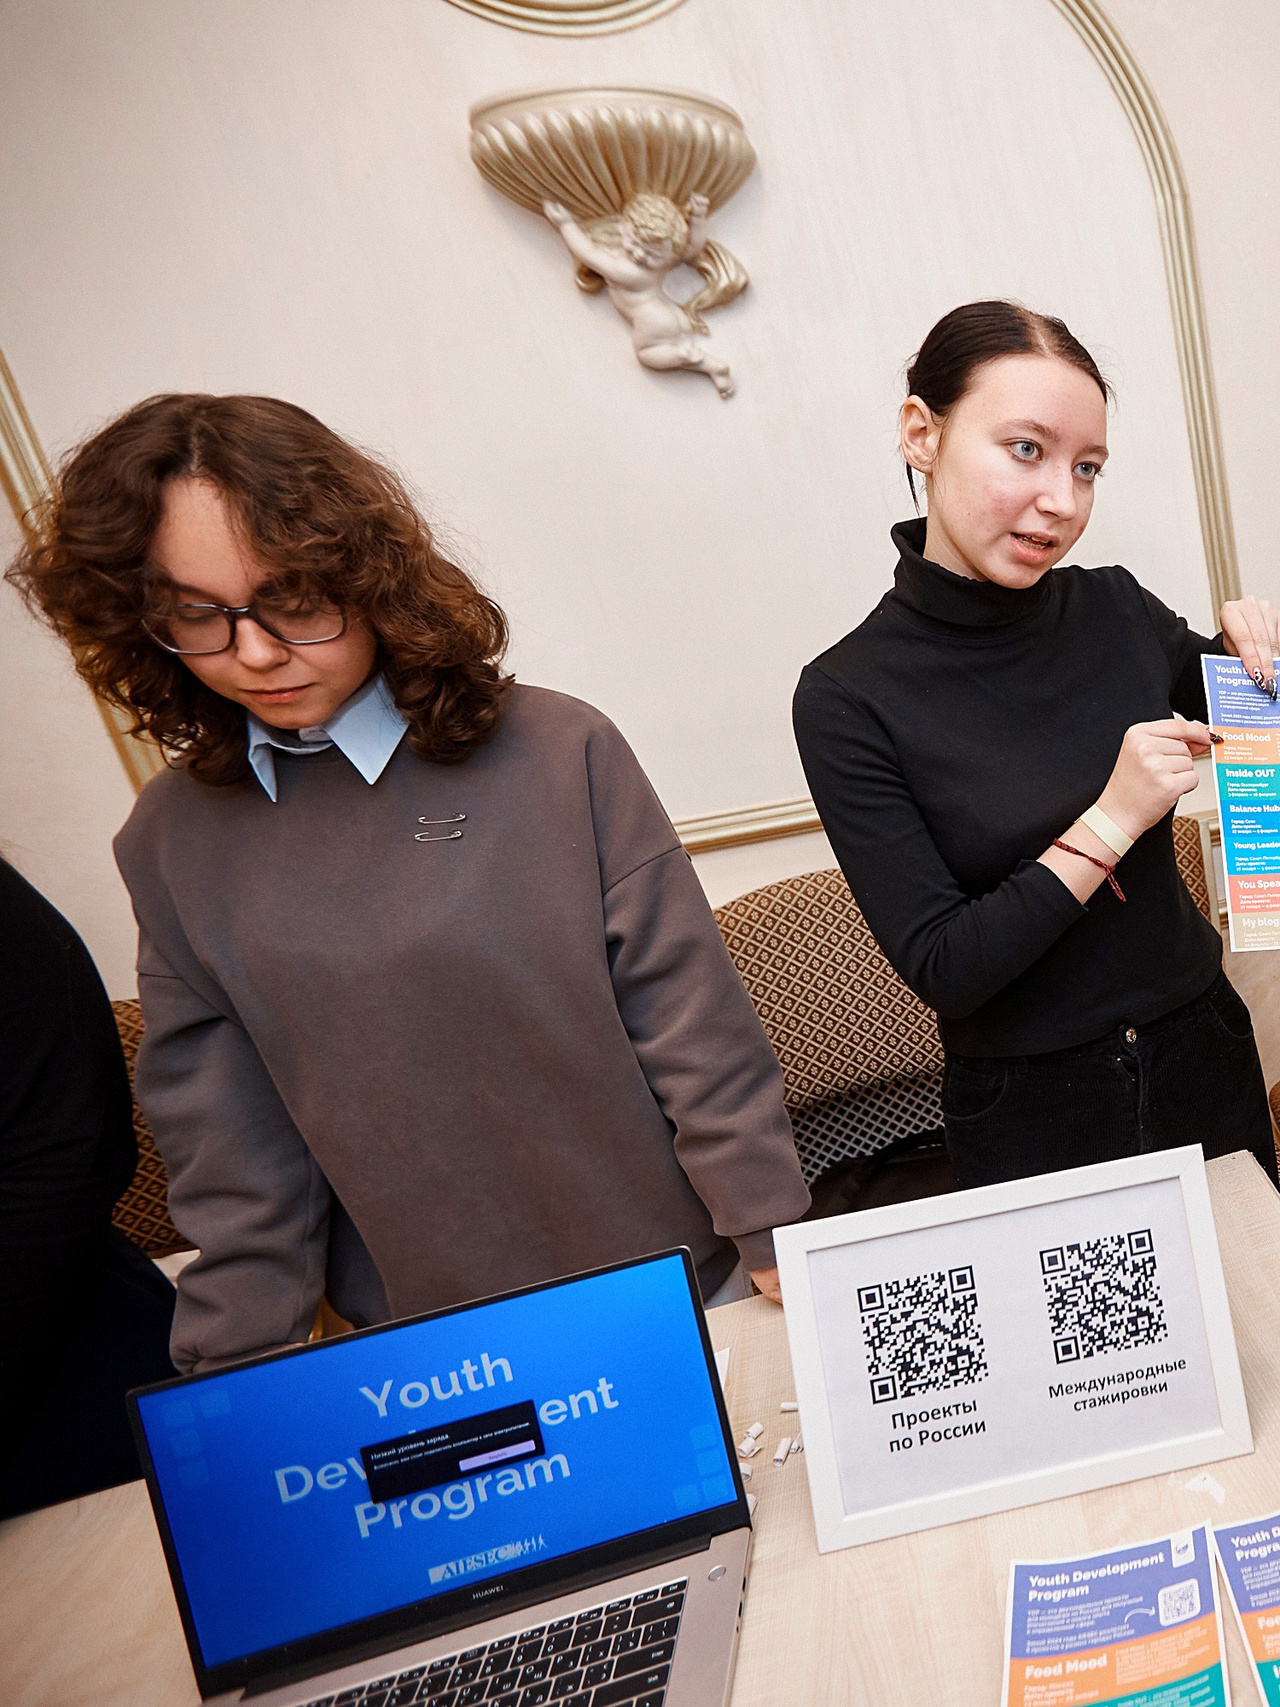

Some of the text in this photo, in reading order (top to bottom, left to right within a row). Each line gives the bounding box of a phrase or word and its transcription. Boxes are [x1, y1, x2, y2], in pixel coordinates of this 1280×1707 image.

[1215, 665, 1242, 674] Youth
[1217, 676, 1255, 687] Program
[1223, 732, 1271, 741] Food Mood
[1226, 769, 1275, 777] Inside OUT
[1234, 842, 1256, 850] Young
[1238, 880, 1256, 889] You
[1242, 918, 1279, 928] My blog
[359, 1352, 514, 1418] Youth
[1048, 1357, 1187, 1399] Международные
[1073, 1380, 1169, 1412] стажировки
[891, 1400, 979, 1430] Проекты
[889, 1420, 987, 1453] по России
[371, 1448, 397, 1461] Низкий
[397, 1440, 425, 1454] уровень
[354, 1451, 571, 1539] Program
[1230, 1529, 1270, 1548] Youth
[440, 1545, 508, 1581] AIESEC
[1029, 1552, 1165, 1587] Youth Development
[472, 1584, 504, 1600] HUAWEI
[1028, 1584, 1090, 1603] Program
[1025, 1654, 1108, 1679] Food Mood
